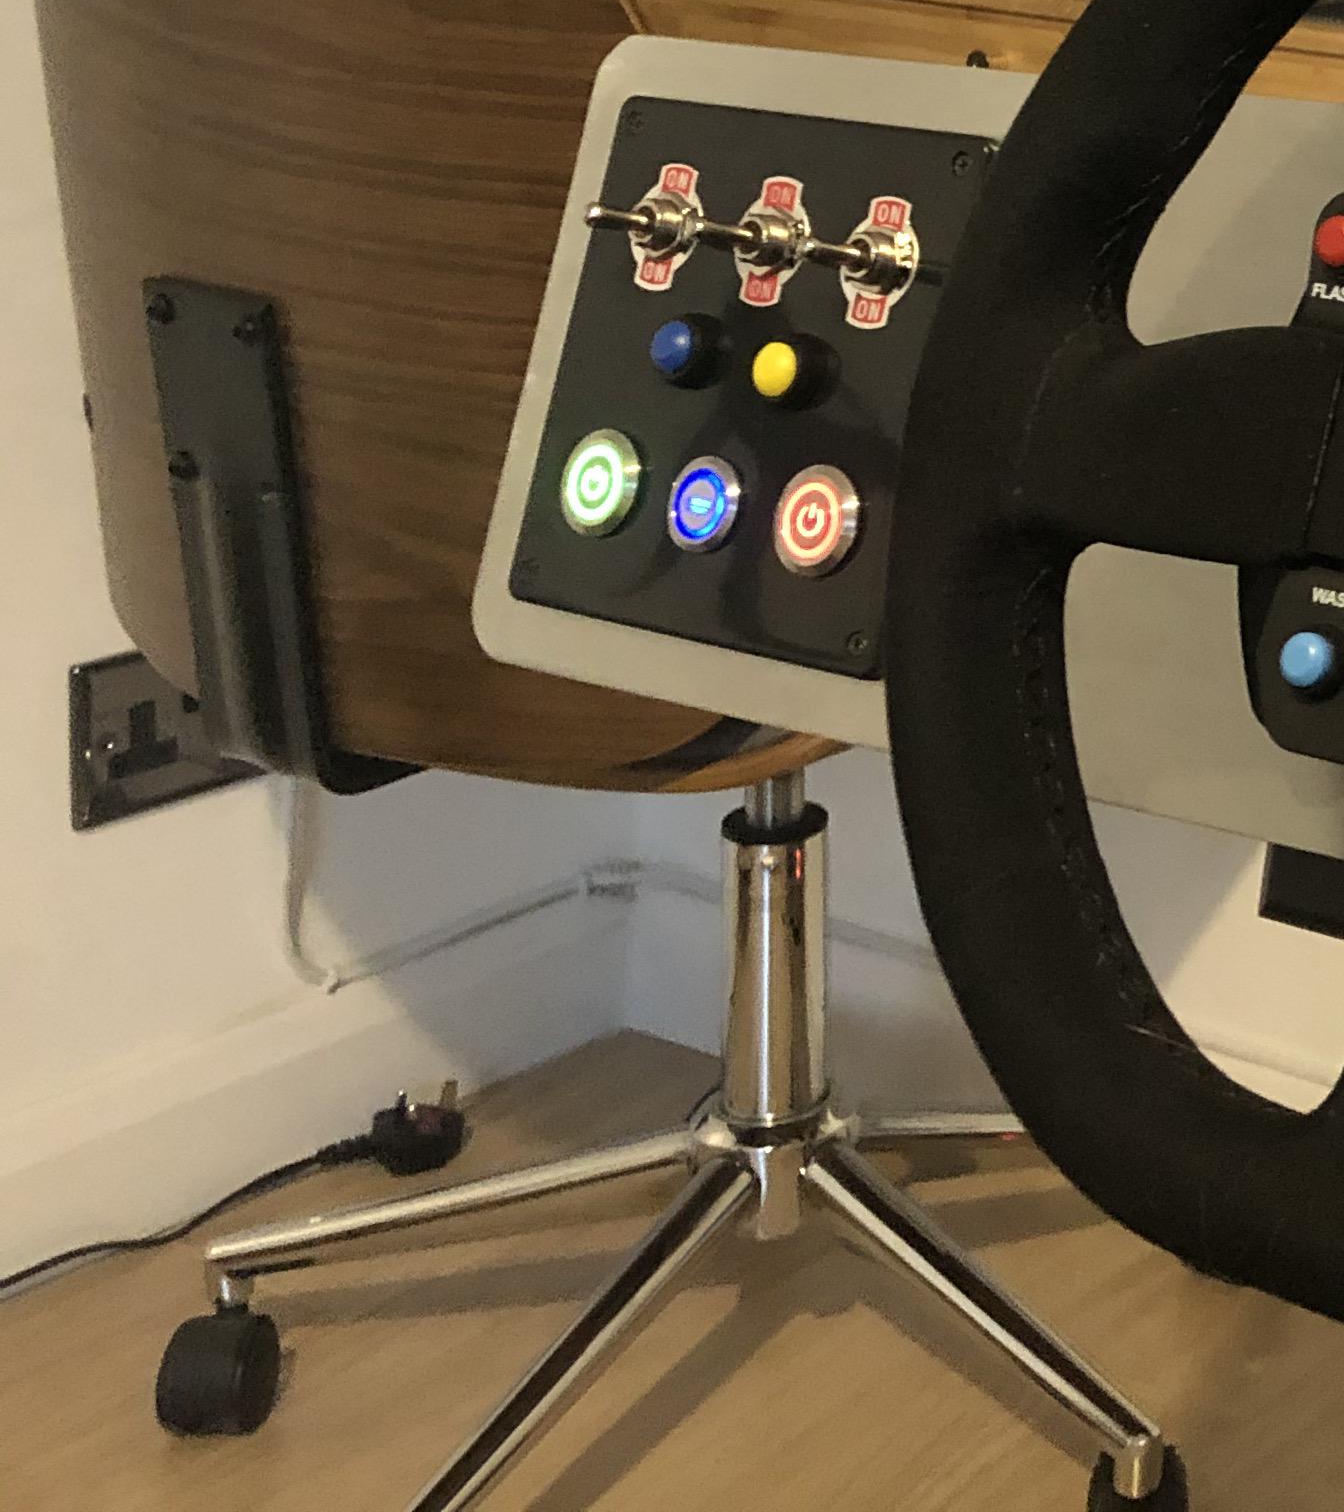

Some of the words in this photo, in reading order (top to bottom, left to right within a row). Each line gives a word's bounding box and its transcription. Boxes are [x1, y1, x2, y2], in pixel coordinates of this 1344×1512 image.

[665, 169, 690, 190] ON
[770, 188, 794, 207] ON
[876, 203, 902, 225] ON
[642, 259, 669, 285] ON
[749, 279, 774, 302] ON
[854, 299, 882, 322] ON
